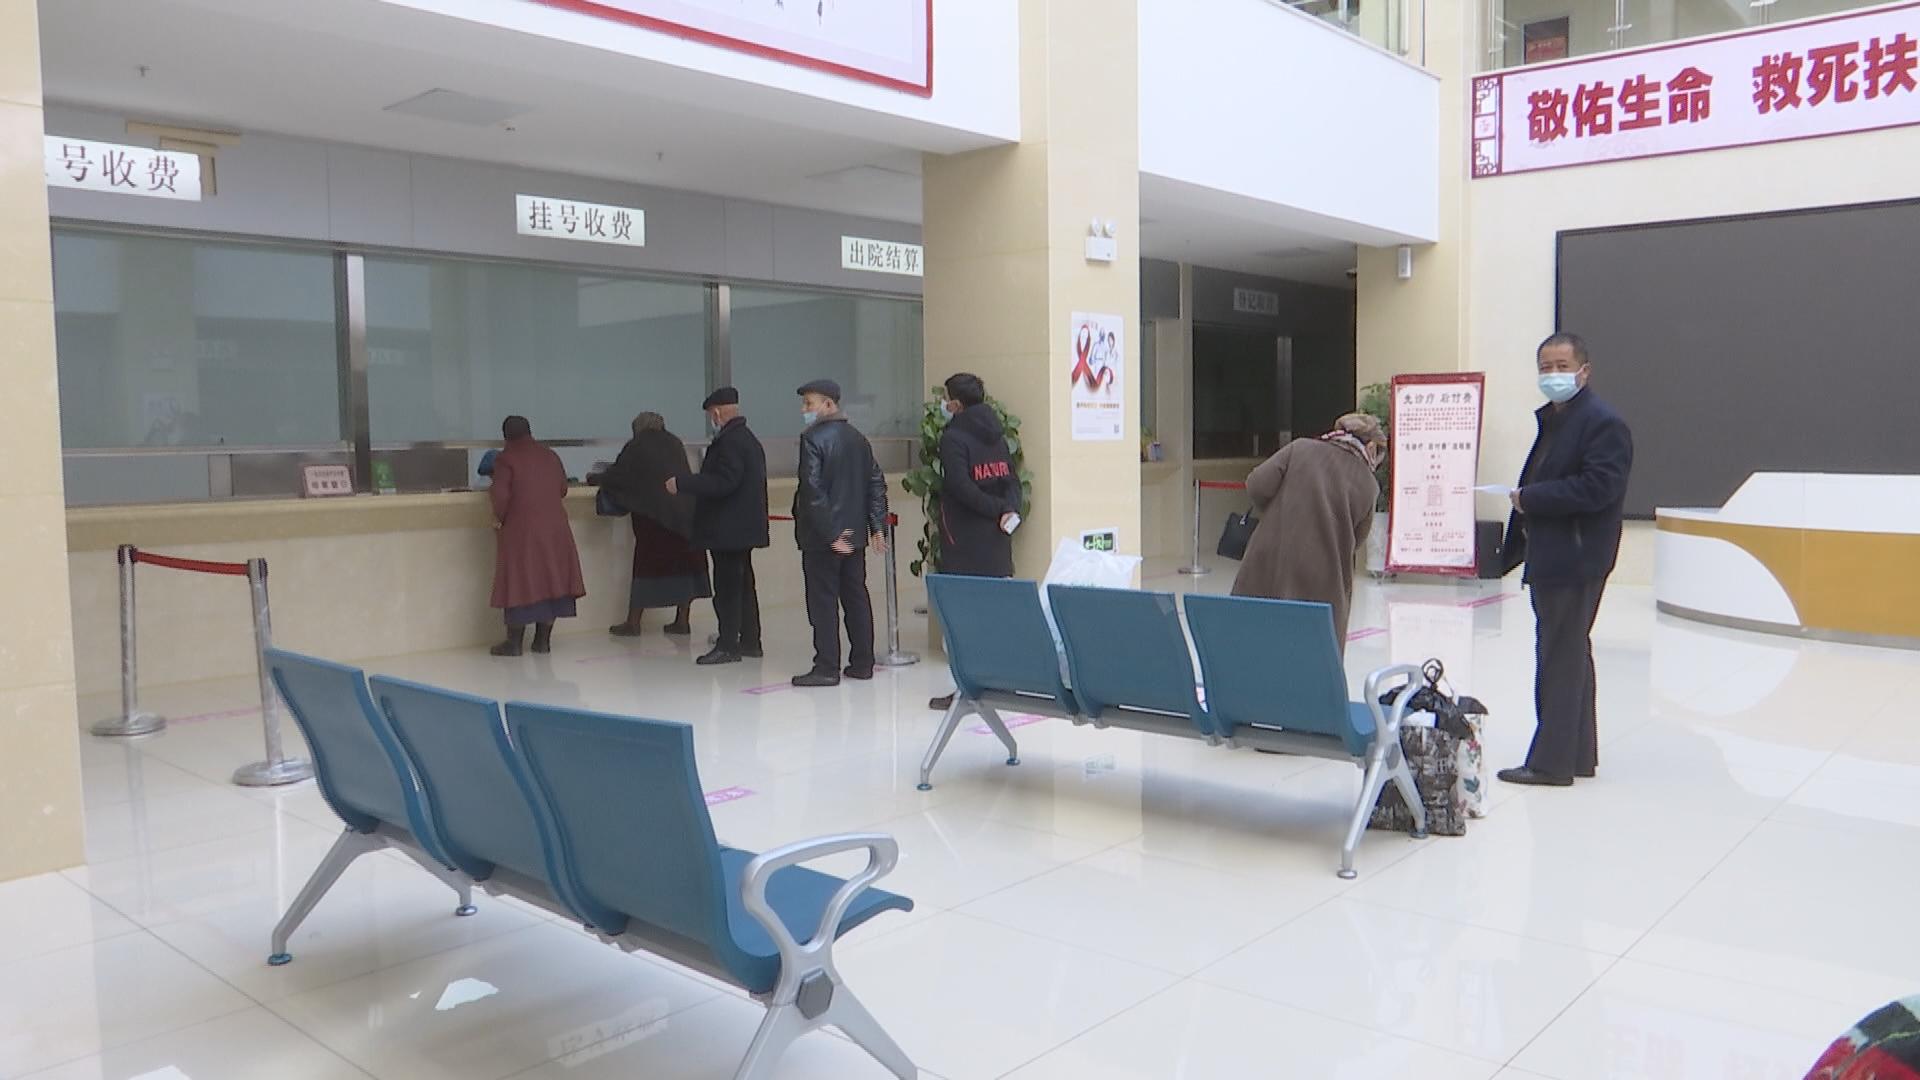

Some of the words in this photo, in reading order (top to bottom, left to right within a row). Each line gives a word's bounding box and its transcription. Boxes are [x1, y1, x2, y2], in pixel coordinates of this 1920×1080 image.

[1526, 66, 1714, 143] 敬佑生命
[1751, 32, 1918, 115] 救死扶
[45, 143, 180, 194] 号收费
[528, 200, 633, 241] 挂号收费
[849, 239, 920, 273] 出院结算
